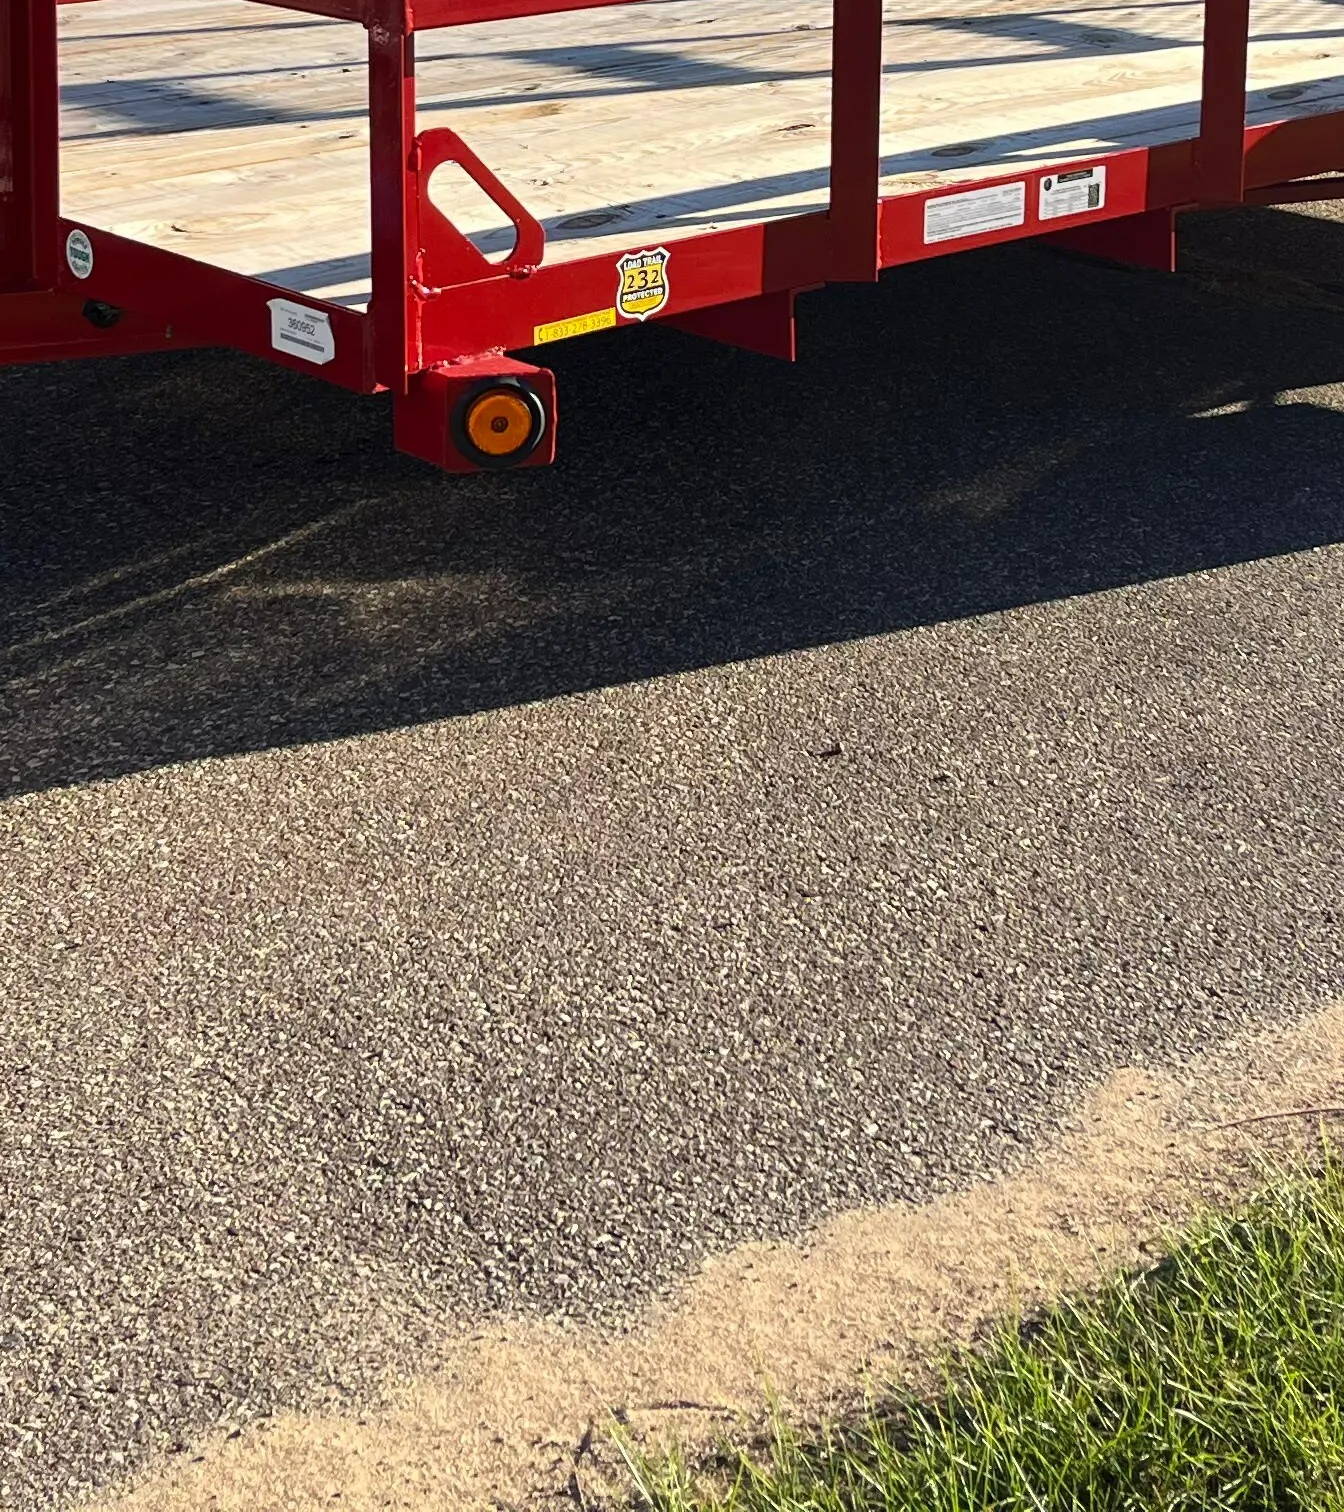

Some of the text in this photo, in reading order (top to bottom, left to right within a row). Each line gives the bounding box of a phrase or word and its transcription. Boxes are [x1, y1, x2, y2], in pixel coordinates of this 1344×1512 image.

[623, 254, 664, 271] LOAD TRAIL
[627, 269, 659, 290] 232
[622, 287, 664, 304] PROTECTED
